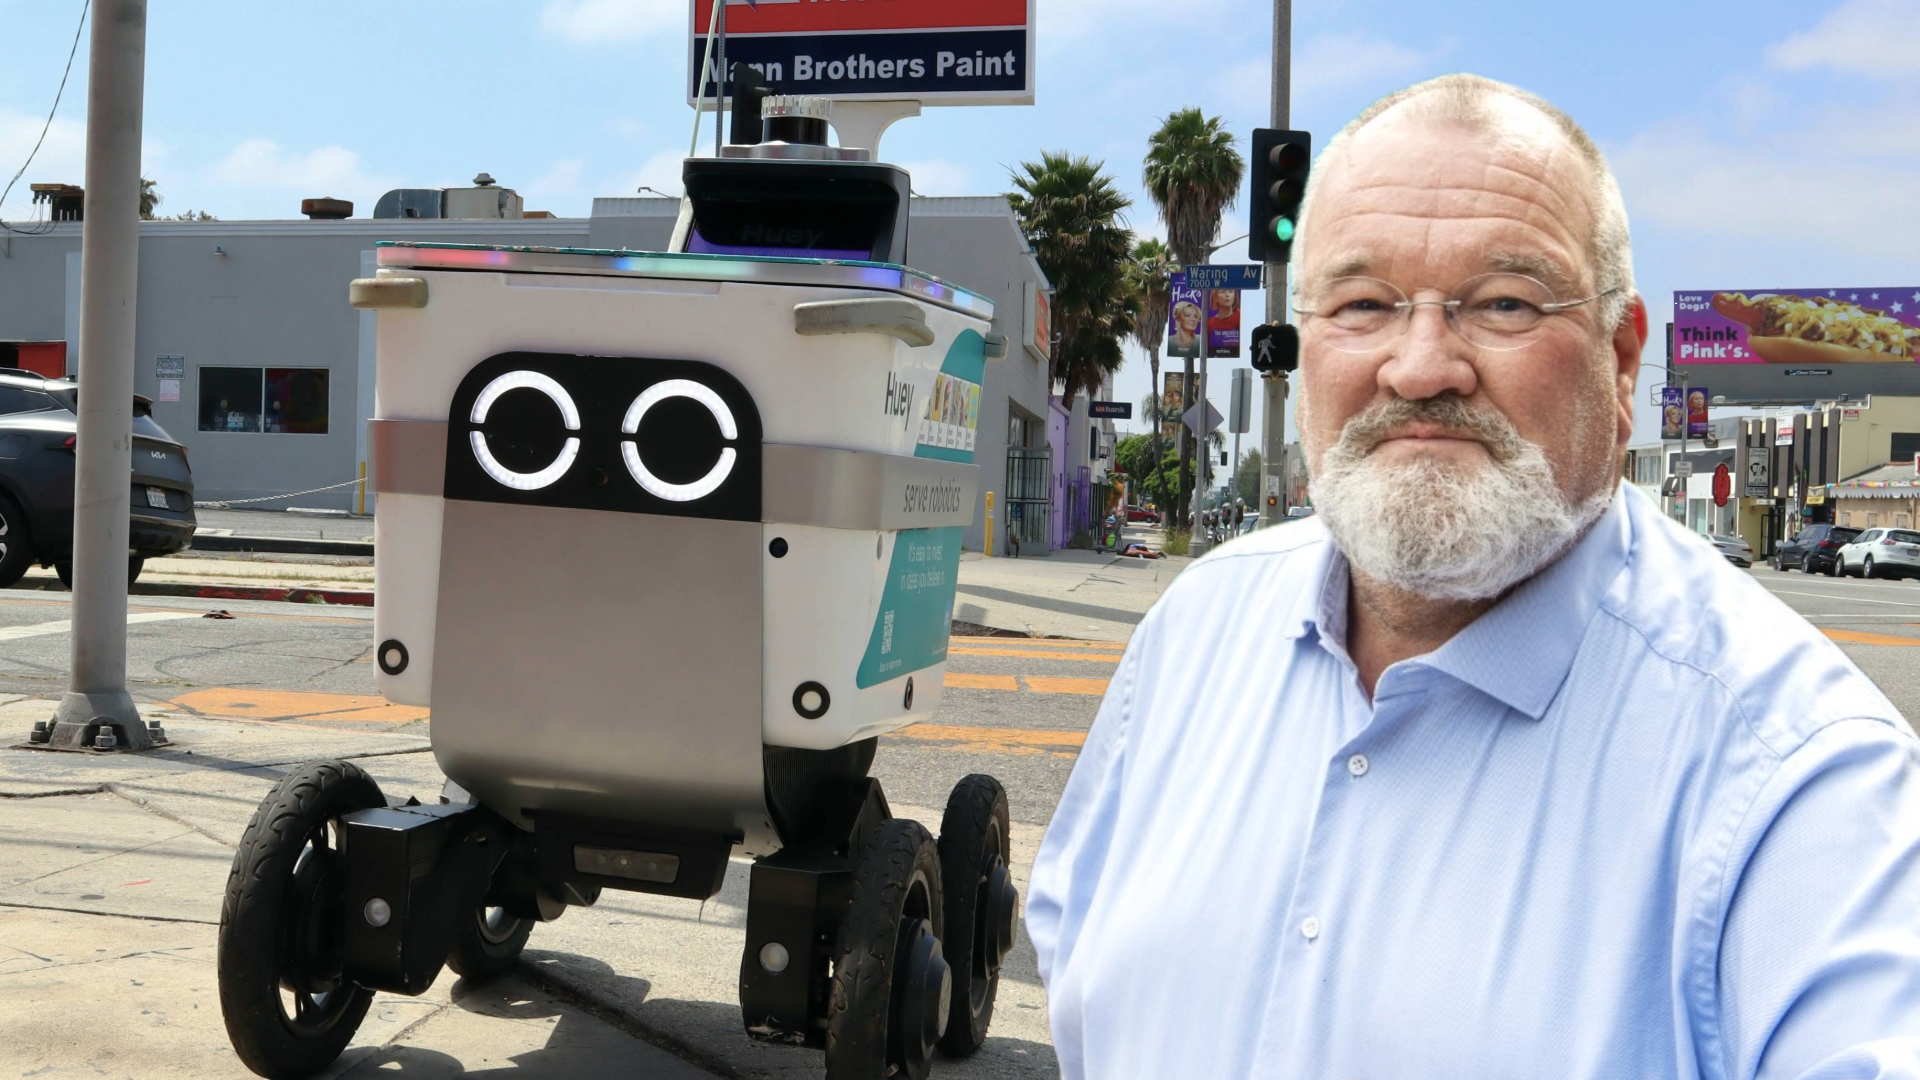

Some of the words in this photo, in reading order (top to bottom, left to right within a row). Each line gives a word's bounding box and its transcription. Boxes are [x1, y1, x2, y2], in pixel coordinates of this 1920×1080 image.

[794, 54, 925, 81] Brothers
[937, 50, 1016, 77] Paint
[740, 224, 825, 249] Huey
[1190, 266, 1228, 283] Waring
[1243, 266, 1257, 279] Av
[1190, 280, 1210, 288] 7000
[1214, 279, 1220, 288] W
[1172, 285, 1202, 304] Hacks
[1679, 302, 1710, 312] Dogs?
[1680, 326, 1739, 341] Think
[1680, 342, 1750, 359] Pink's.
[884, 370, 915, 432] Huey
[903, 483, 928, 513] serve
[928, 475, 961, 513] robotics
